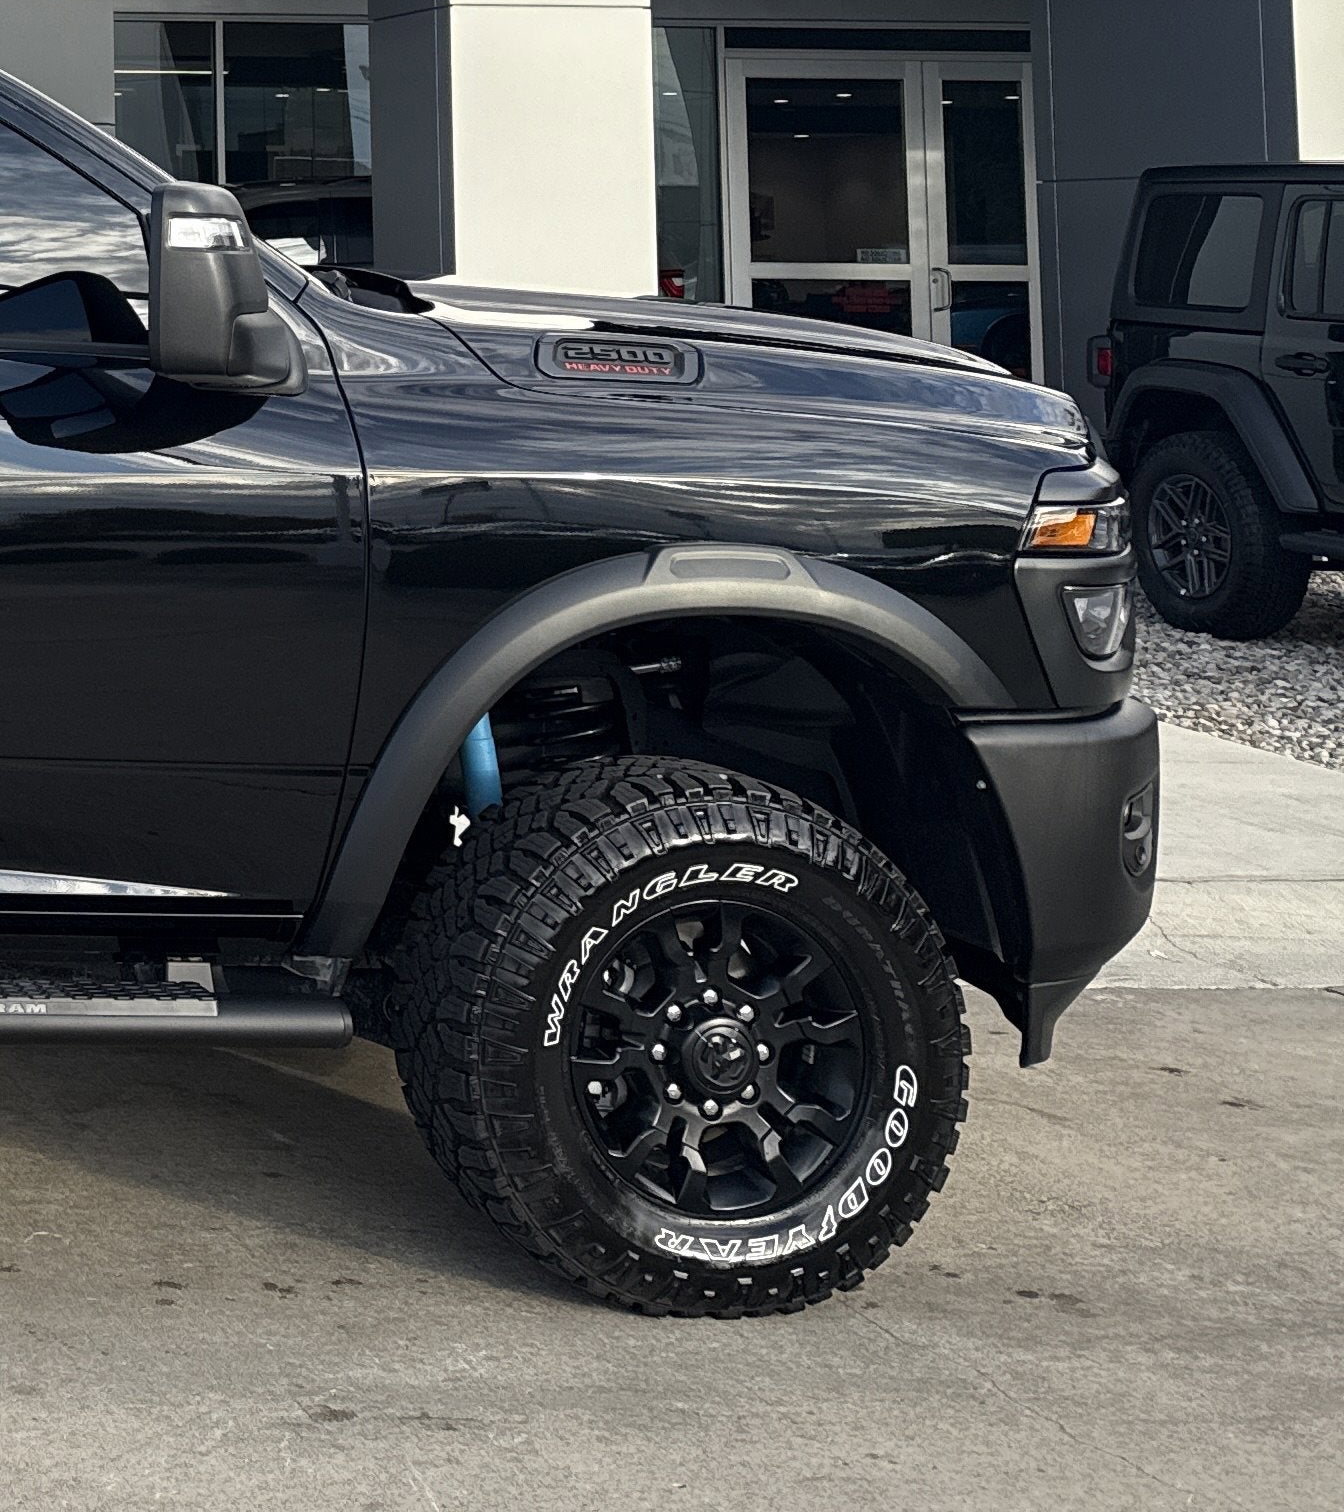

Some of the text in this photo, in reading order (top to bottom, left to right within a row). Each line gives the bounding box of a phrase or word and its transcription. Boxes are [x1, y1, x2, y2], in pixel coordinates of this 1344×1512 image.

[562, 346, 672, 365] 2500
[564, 362, 672, 375] HEAVY DUTY
[544, 863, 799, 1047] WRANGLER
[655, 1065, 918, 1262] GOODYEAR
